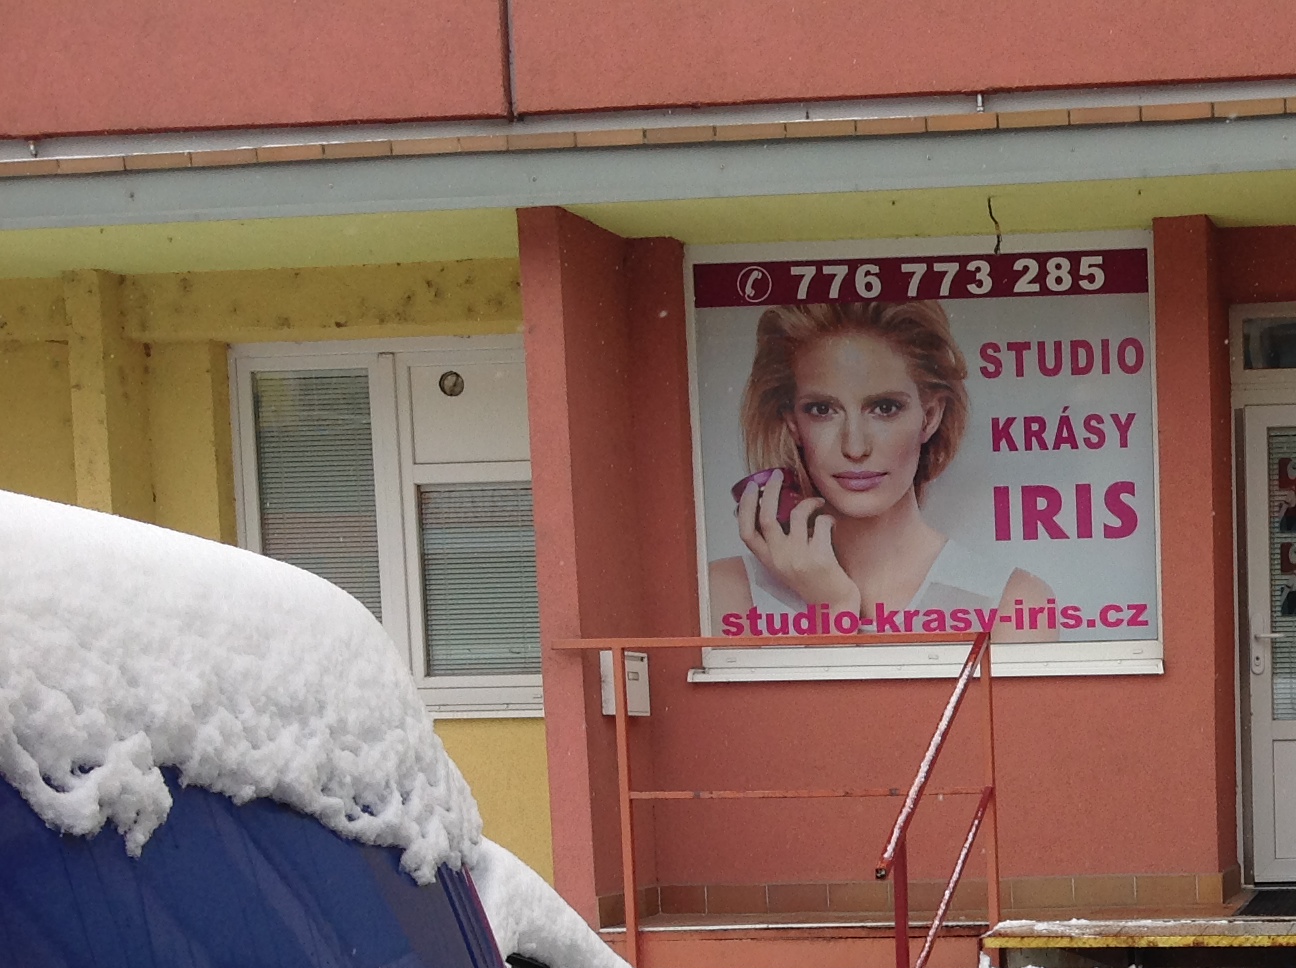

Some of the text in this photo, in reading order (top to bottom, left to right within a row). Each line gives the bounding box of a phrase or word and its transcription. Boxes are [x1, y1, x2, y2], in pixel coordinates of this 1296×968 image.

[790, 256, 1105, 300] 776 773 285
[979, 337, 1145, 379] STUDIO
[991, 406, 1137, 452] KRÁSY
[993, 481, 1138, 541] IRIS
[721, 598, 1149, 636] studio-krasy-iris.cz
